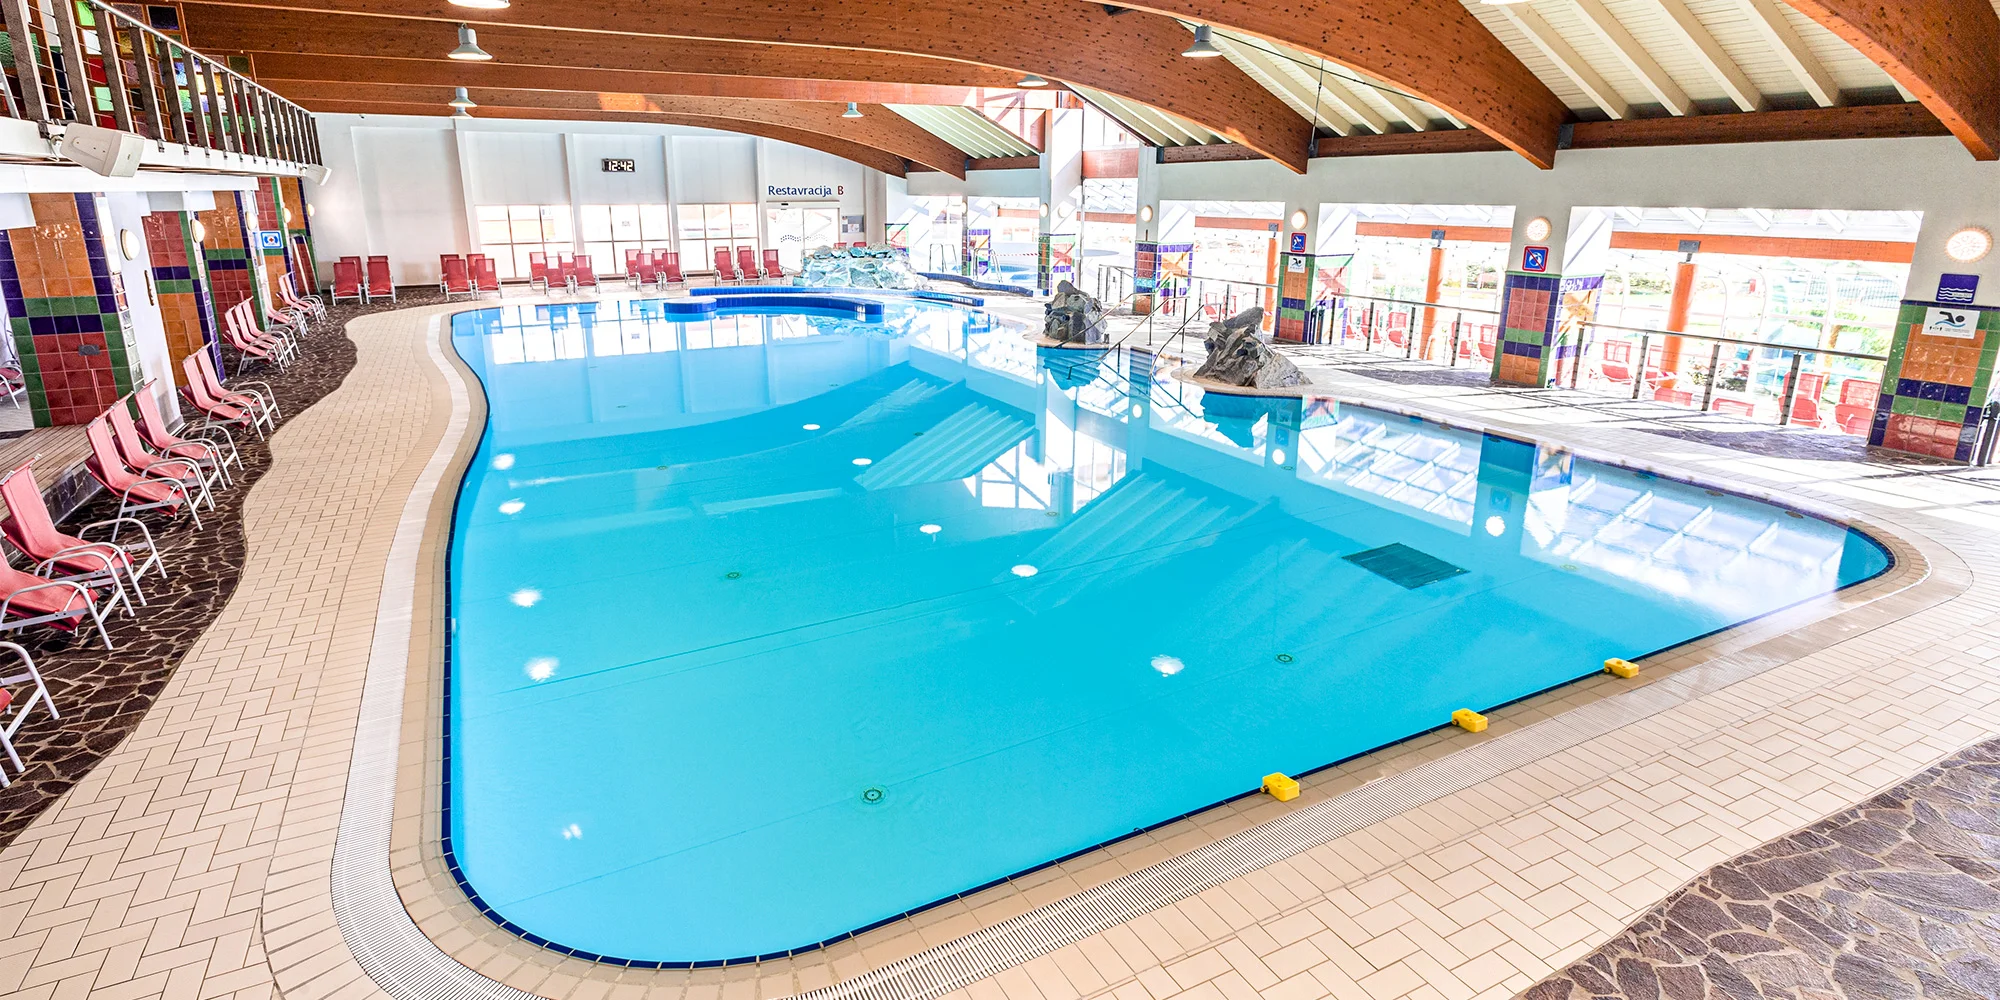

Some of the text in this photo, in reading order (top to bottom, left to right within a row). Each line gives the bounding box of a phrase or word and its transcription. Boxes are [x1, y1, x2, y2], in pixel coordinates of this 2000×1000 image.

[608, 160, 634, 172] 12:42
[768, 185, 844, 198] Restavracija B
